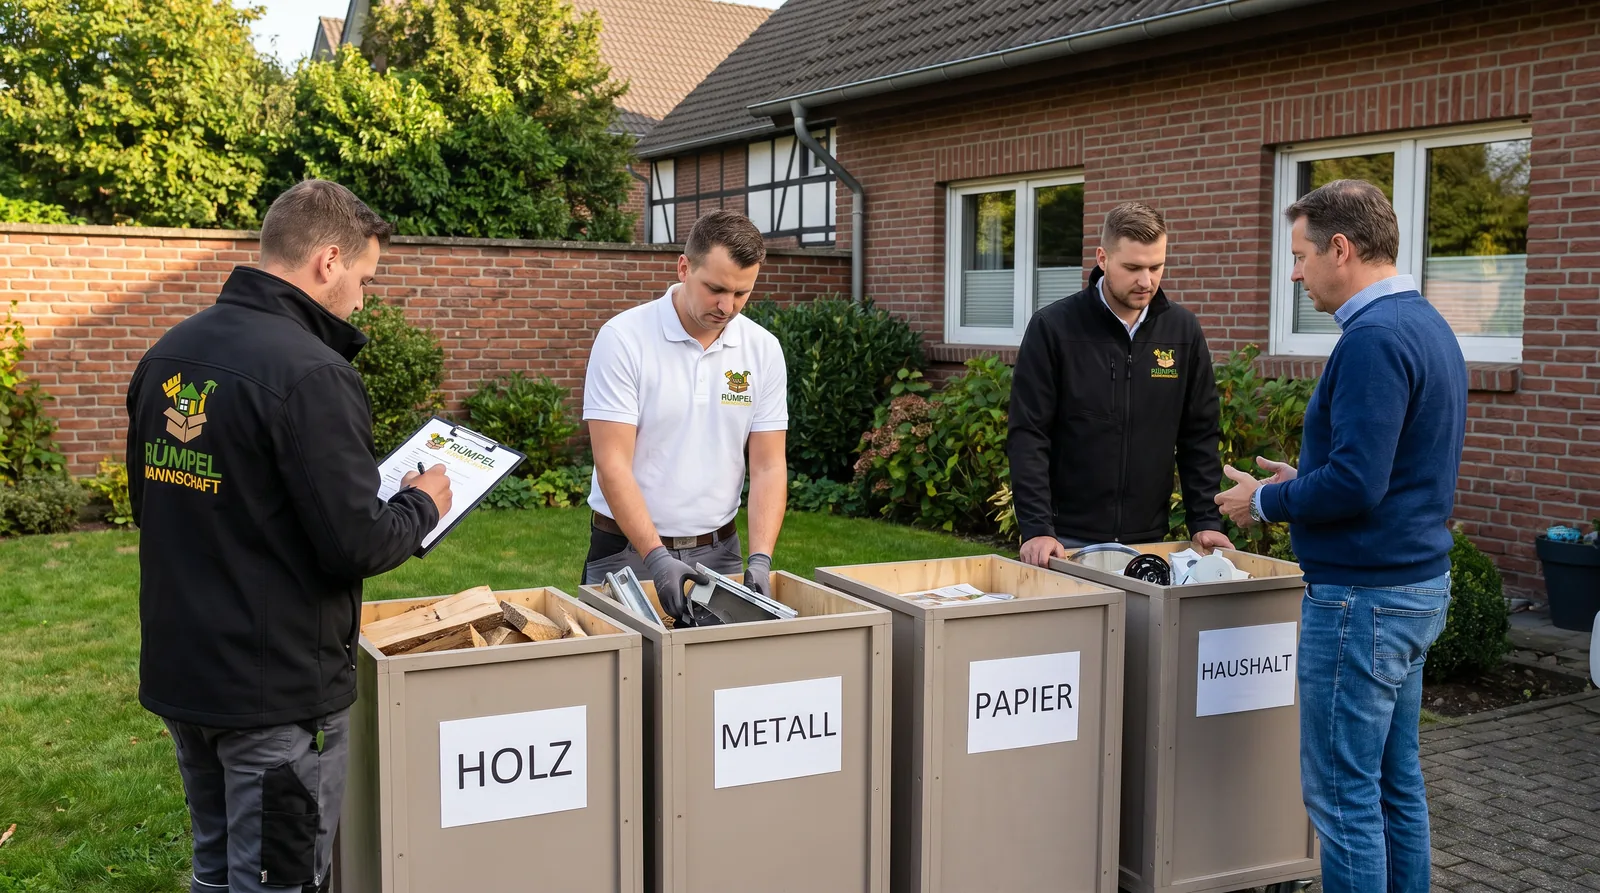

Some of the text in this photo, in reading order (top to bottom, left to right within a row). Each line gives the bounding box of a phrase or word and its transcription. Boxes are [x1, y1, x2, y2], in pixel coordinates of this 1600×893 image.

[721, 392, 753, 403] RÜMPEL
[145, 438, 222, 478] RÜMPEL
[449, 442, 496, 468] RÜMPEL
[1202, 653, 1293, 681] HAUSHALT
[976, 683, 1073, 720] PAPIER
[722, 711, 837, 750] METALL
[457, 740, 573, 790] HOLZ
